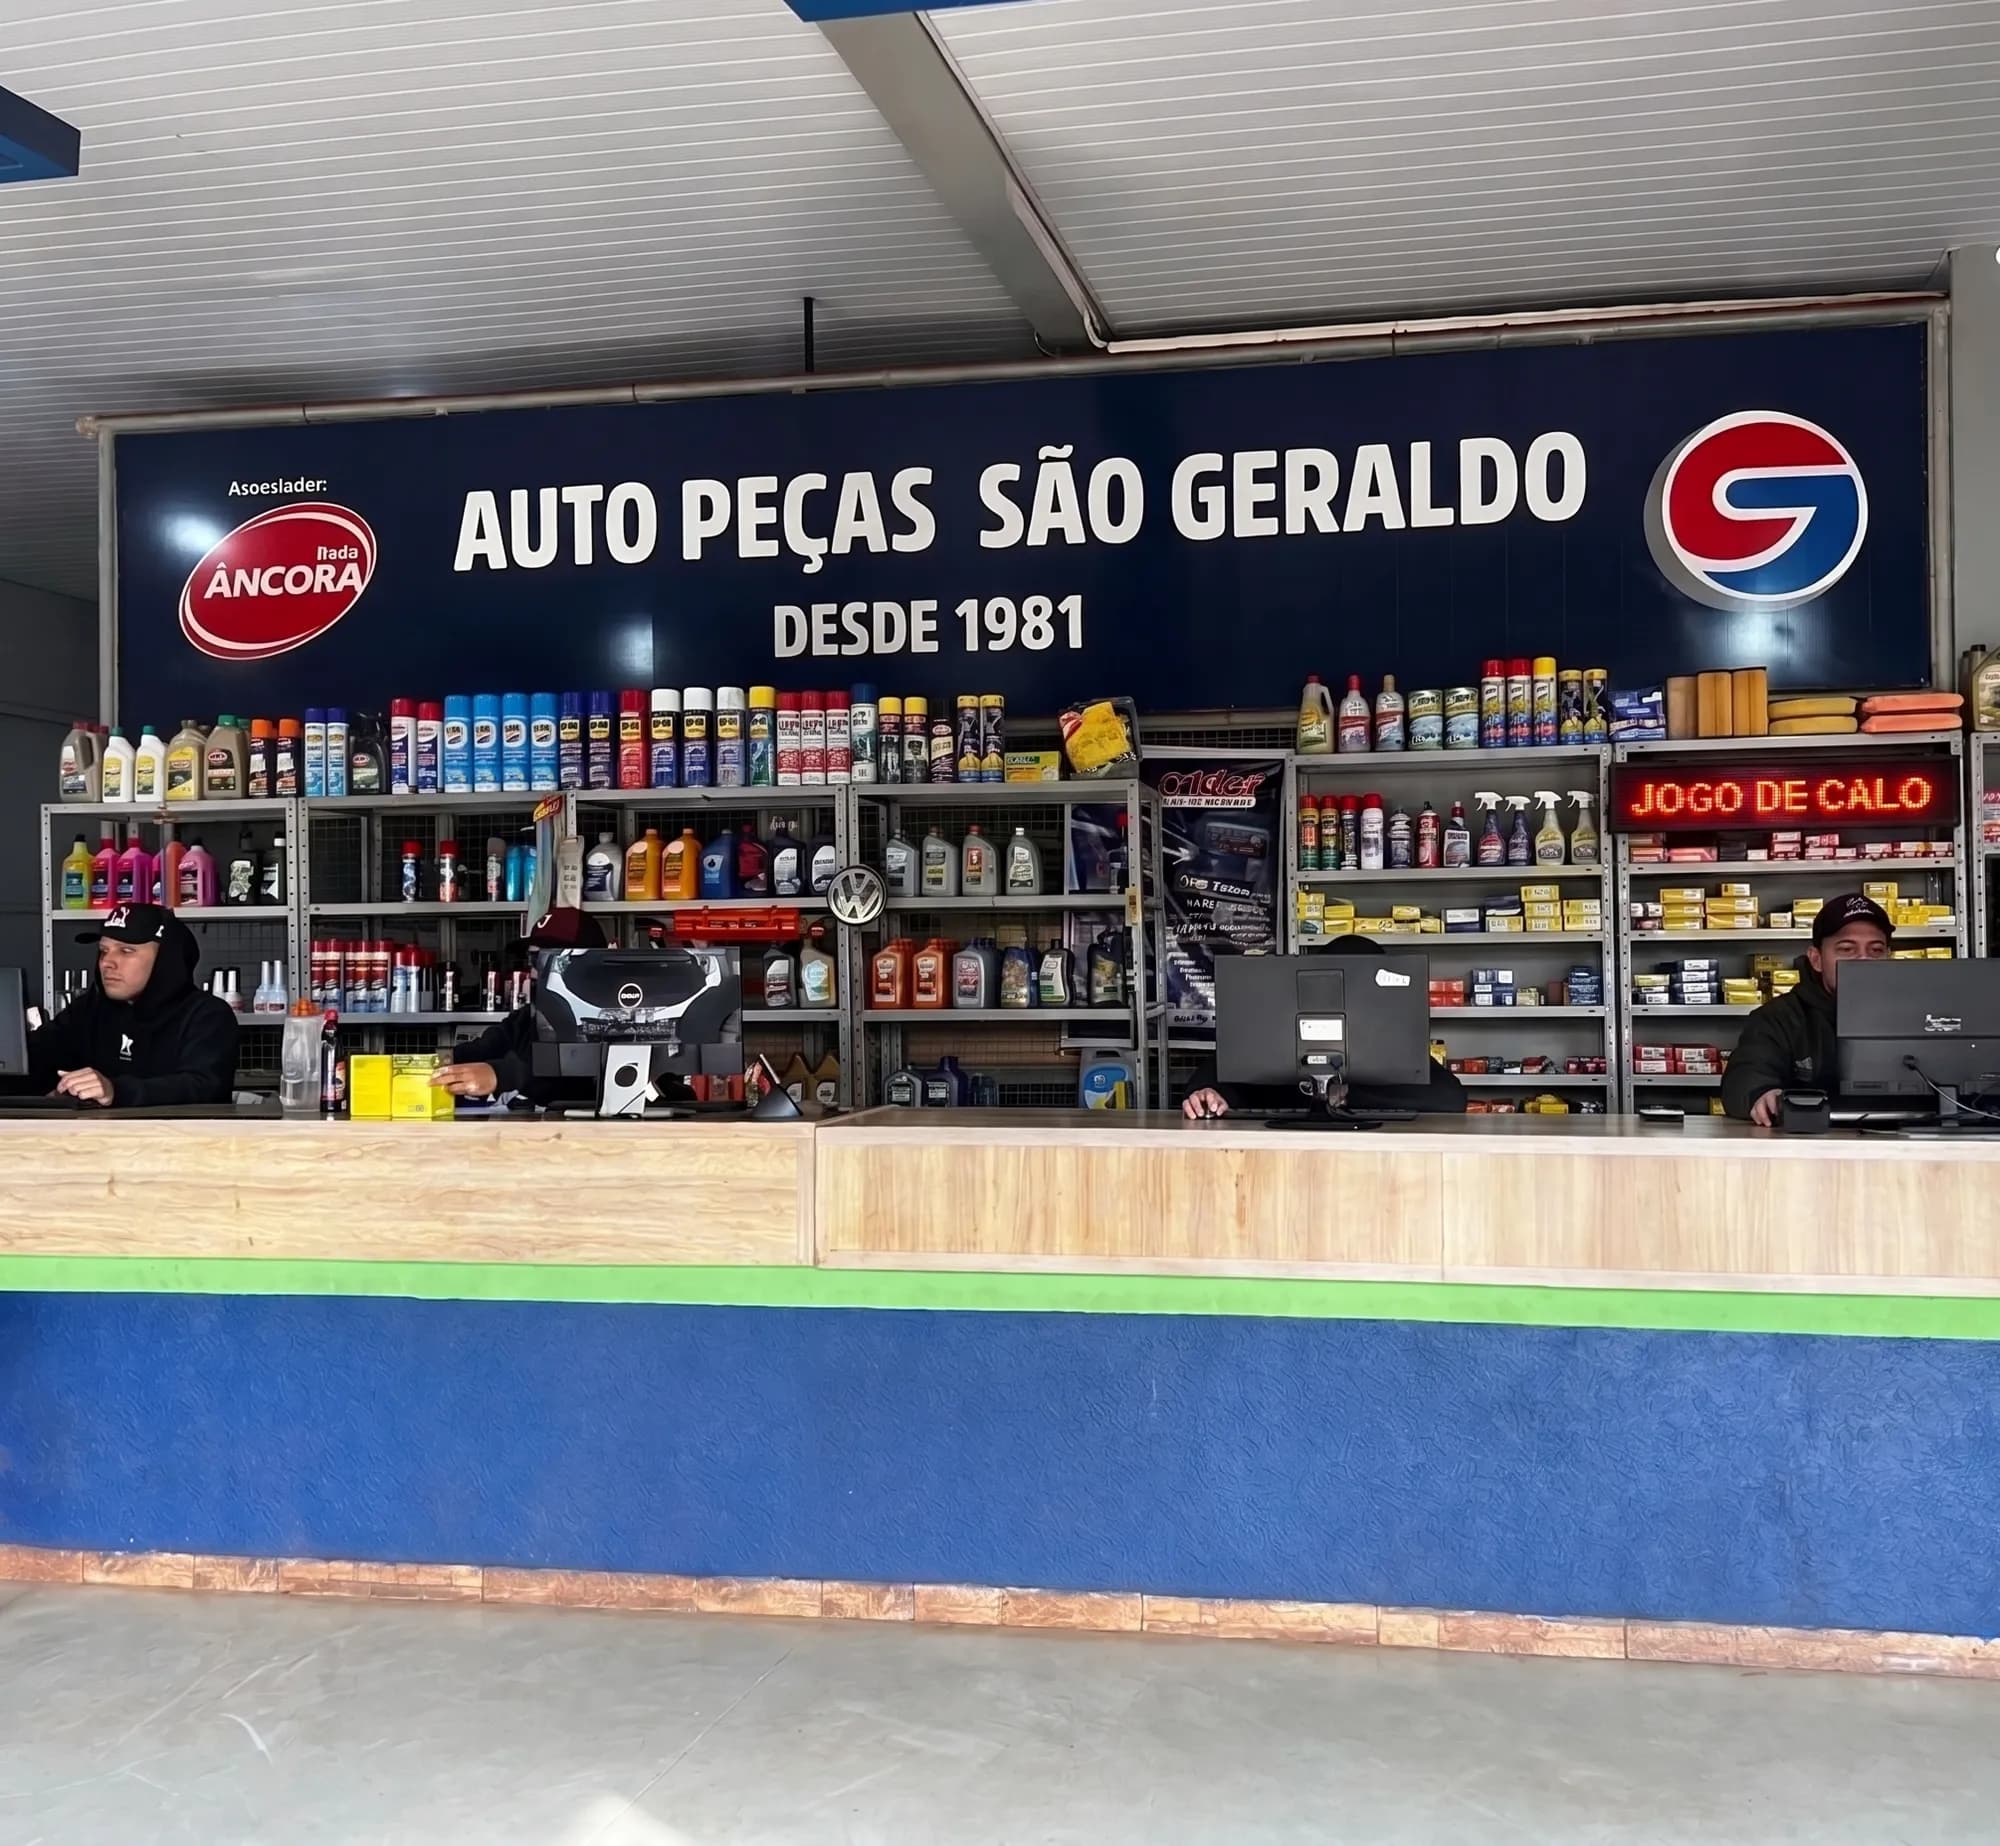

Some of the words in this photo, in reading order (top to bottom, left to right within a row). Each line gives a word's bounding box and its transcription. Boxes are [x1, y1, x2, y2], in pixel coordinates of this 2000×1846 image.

[228, 476, 328, 497] Asoeslader:
[453, 481, 658, 573] AUTO
[681, 466, 936, 575] PEÇAS
[979, 444, 1144, 549] SÃO
[1171, 431, 1588, 541] GERALDO
[203, 561, 364, 600] ÂNCORA
[774, 599, 940, 659] DESDE
[954, 594, 1084, 652] 1981
[1631, 783, 1744, 815] JOGO
[1756, 780, 1809, 811] DE
[1816, 777, 1932, 811] CALO
